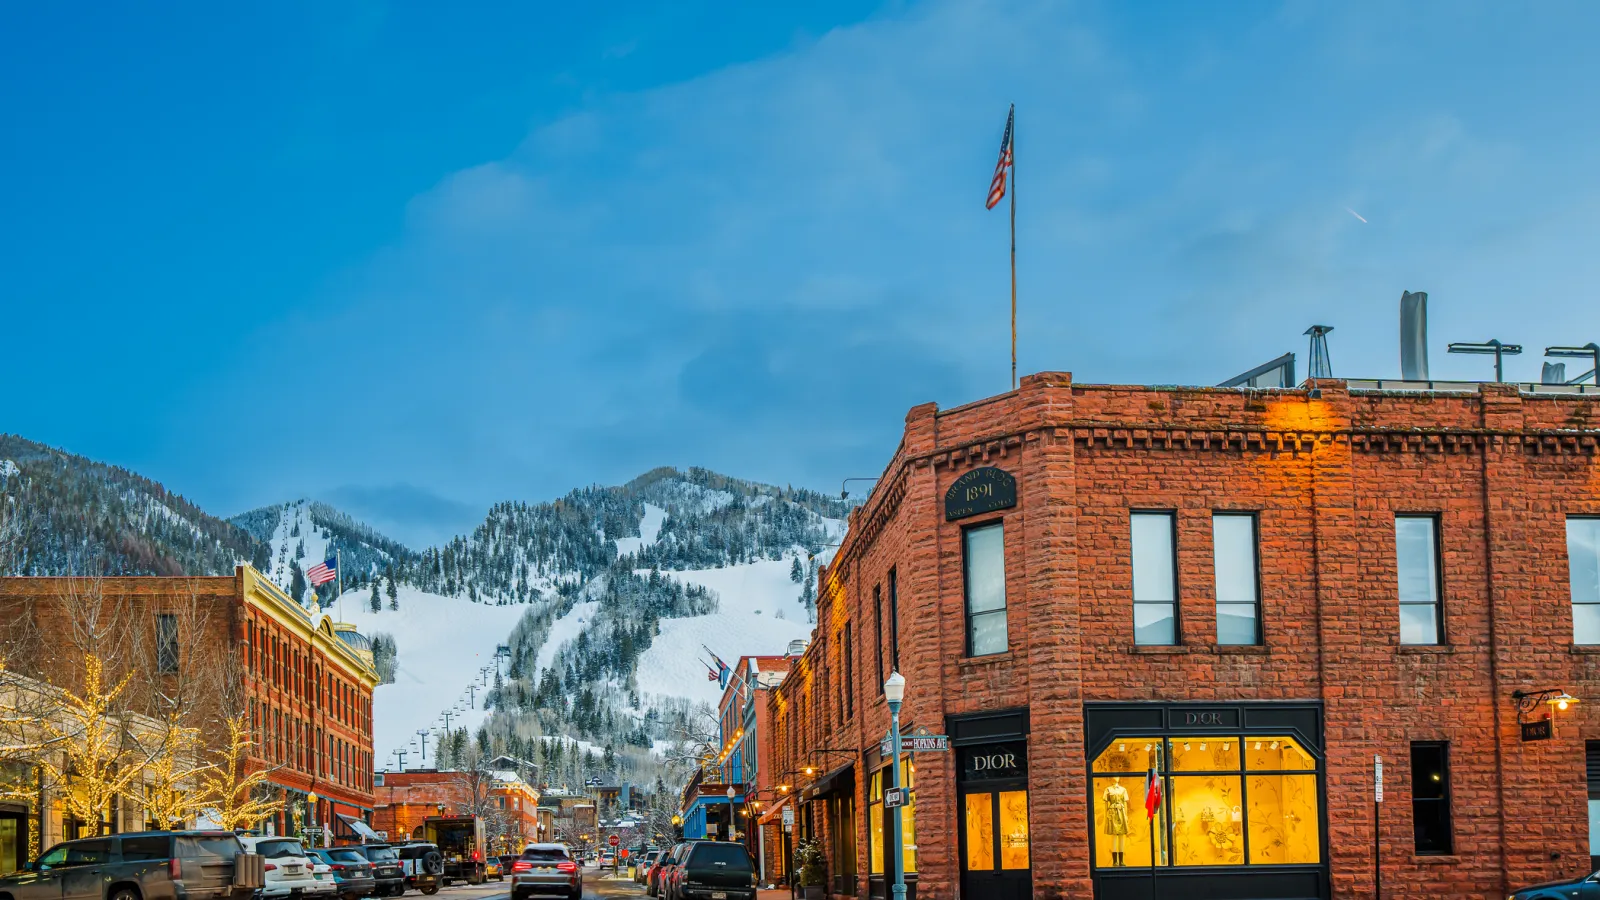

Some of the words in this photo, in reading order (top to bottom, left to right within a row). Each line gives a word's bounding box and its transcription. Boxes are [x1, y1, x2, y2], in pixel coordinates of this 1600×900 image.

[947, 470, 980, 499] BRAND
[966, 483, 992, 502] 1891
[949, 507, 973, 516] ASPEN
[1185, 712, 1222, 725] DIOR
[913, 738, 935, 749] HOPKINS
[936, 738, 946, 749] AVE
[973, 753, 1016, 771] DIOR
